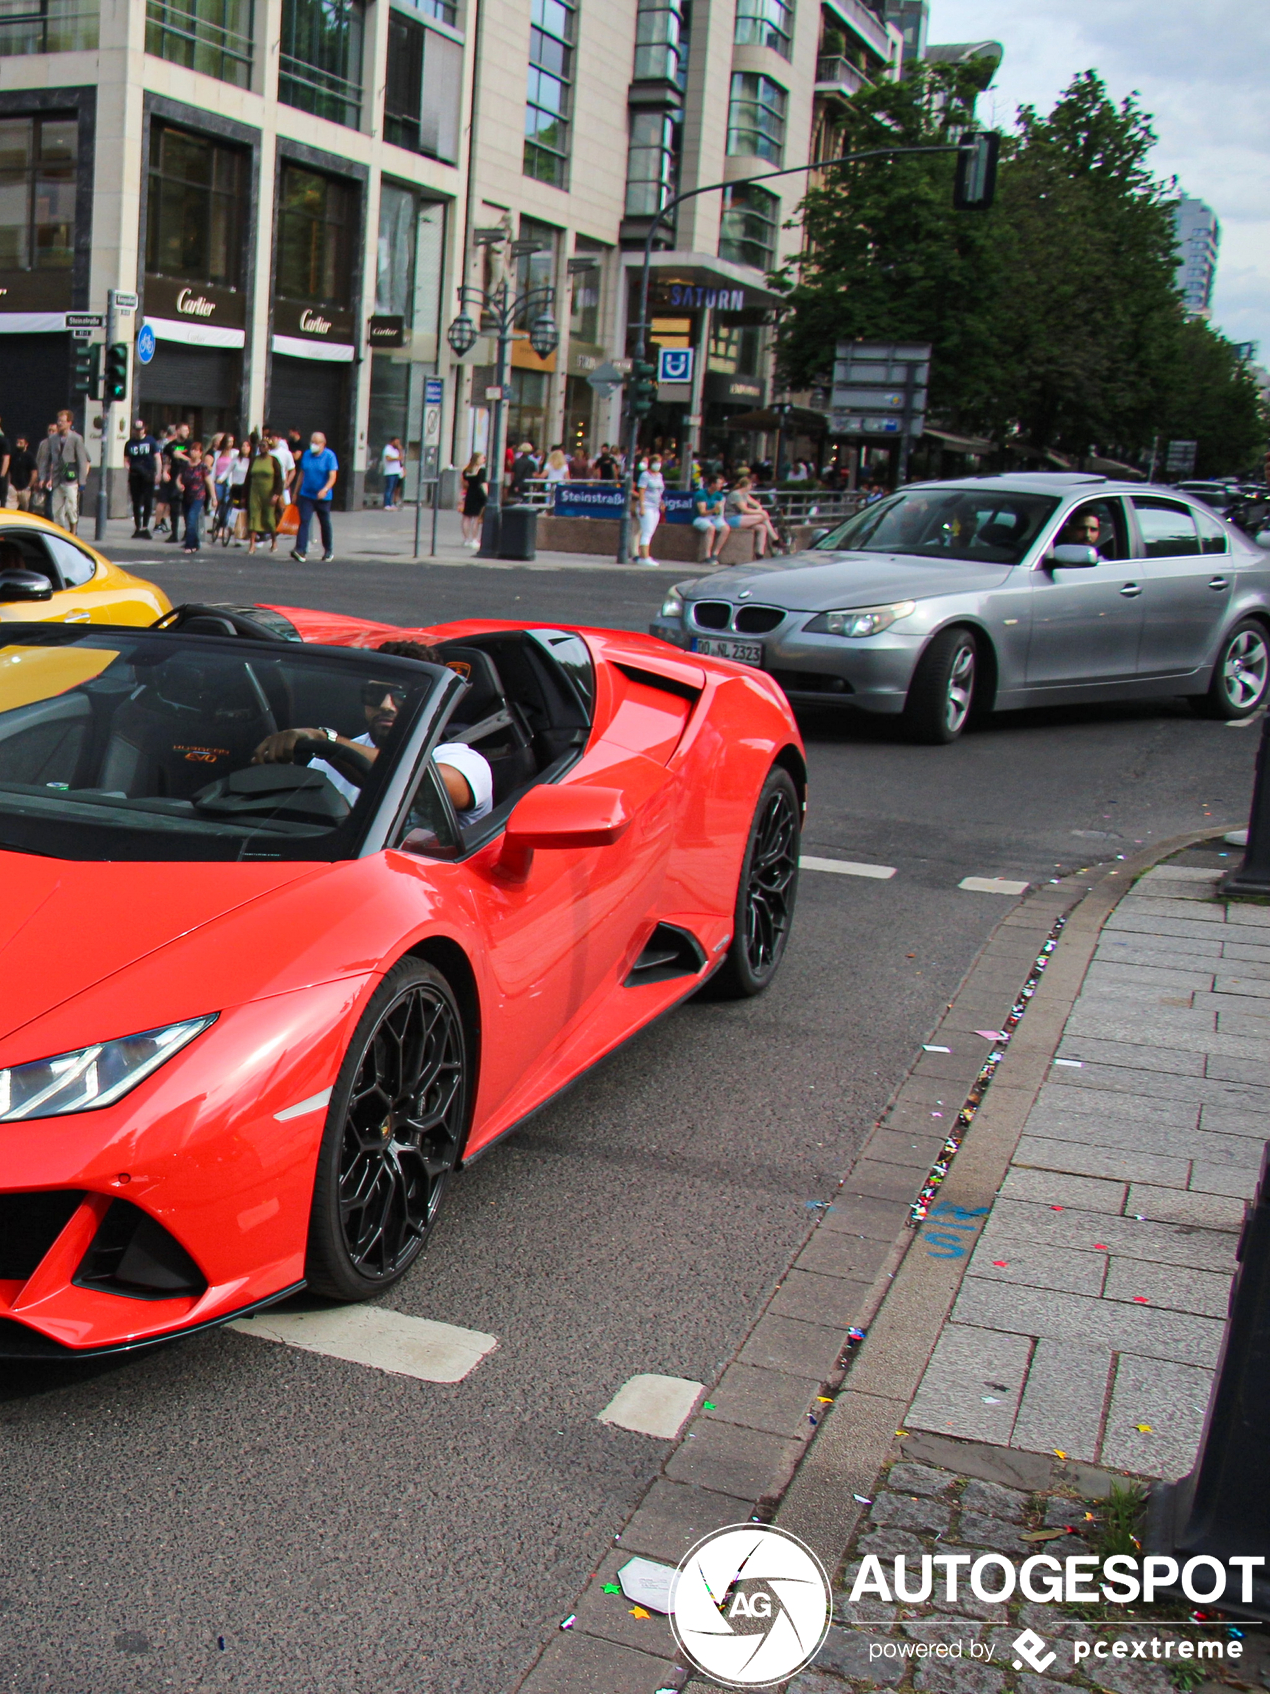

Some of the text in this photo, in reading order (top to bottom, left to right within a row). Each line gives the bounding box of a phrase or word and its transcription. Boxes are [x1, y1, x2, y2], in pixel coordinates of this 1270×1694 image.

[177, 287, 216, 317] Cartier
[671, 285, 744, 312] SATURN
[69, 316, 100, 326] Steinstraße
[300, 309, 332, 335] Cartier
[372, 326, 399, 337] Cartier
[716, 642, 731, 658] NL
[732, 644, 761, 662] 2323
[184, 752, 218, 764] EVO
